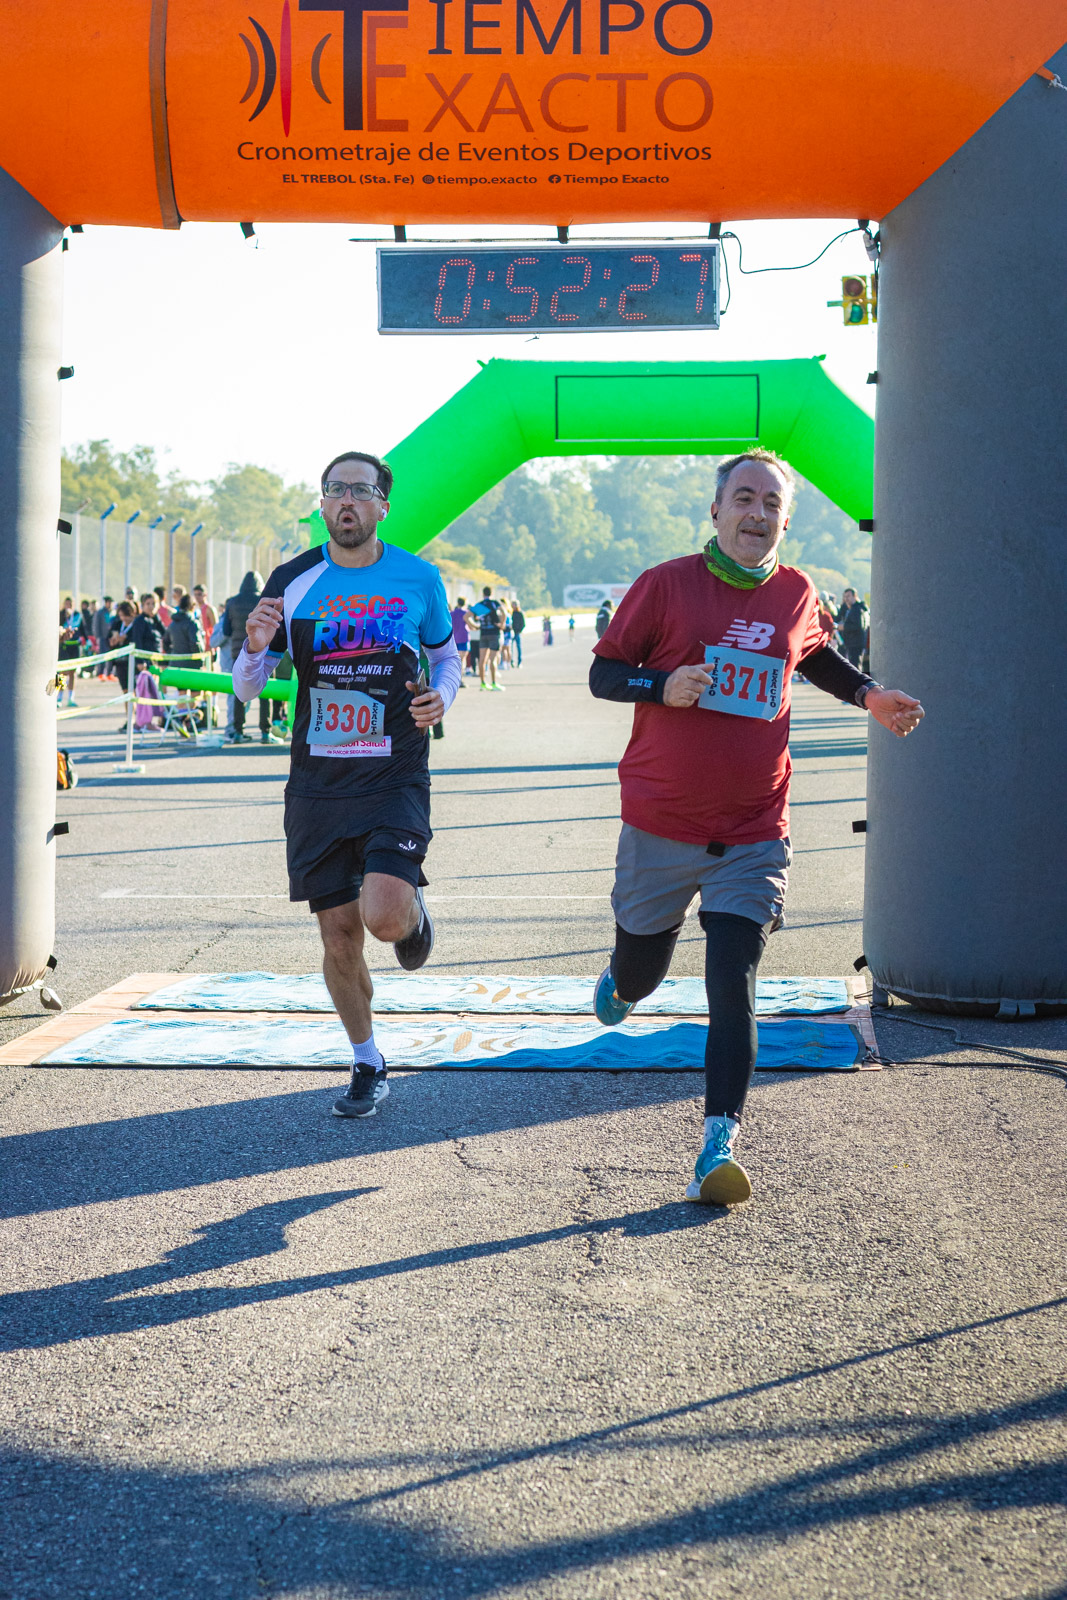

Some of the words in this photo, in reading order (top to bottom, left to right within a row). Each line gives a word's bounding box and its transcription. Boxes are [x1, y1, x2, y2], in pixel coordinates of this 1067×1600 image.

[237, 141, 412, 166] Cronometraje
[418, 142, 450, 161] de
[458, 142, 560, 161] Eventos
[568, 142, 712, 166] Deportivos
[282, 174, 299, 183] EL
[301, 174, 356, 184] TREBOL
[359, 174, 391, 185] (Sta.
[394, 174, 415, 185] Fe)
[437, 175, 538, 187] tiempo.exacto
[563, 174, 618, 186] Tiempo
[622, 174, 670, 184] Exacto
[433, 254, 709, 324] 0:52:27
[379, 605, 408, 613] MILLAS
[312, 618, 405, 652] RUN
[318, 664, 355, 676] RAFAELA,
[356, 664, 382, 675] SANTA
[383, 665, 394, 676] FE
[708, 656, 720, 697] TIEMPO
[720, 662, 769, 704] 371
[769, 668, 779, 708] EXACTO
[314, 697, 323, 733] TIEMPO
[325, 703, 371, 735] 330
[370, 702, 379, 736] EXACTO
